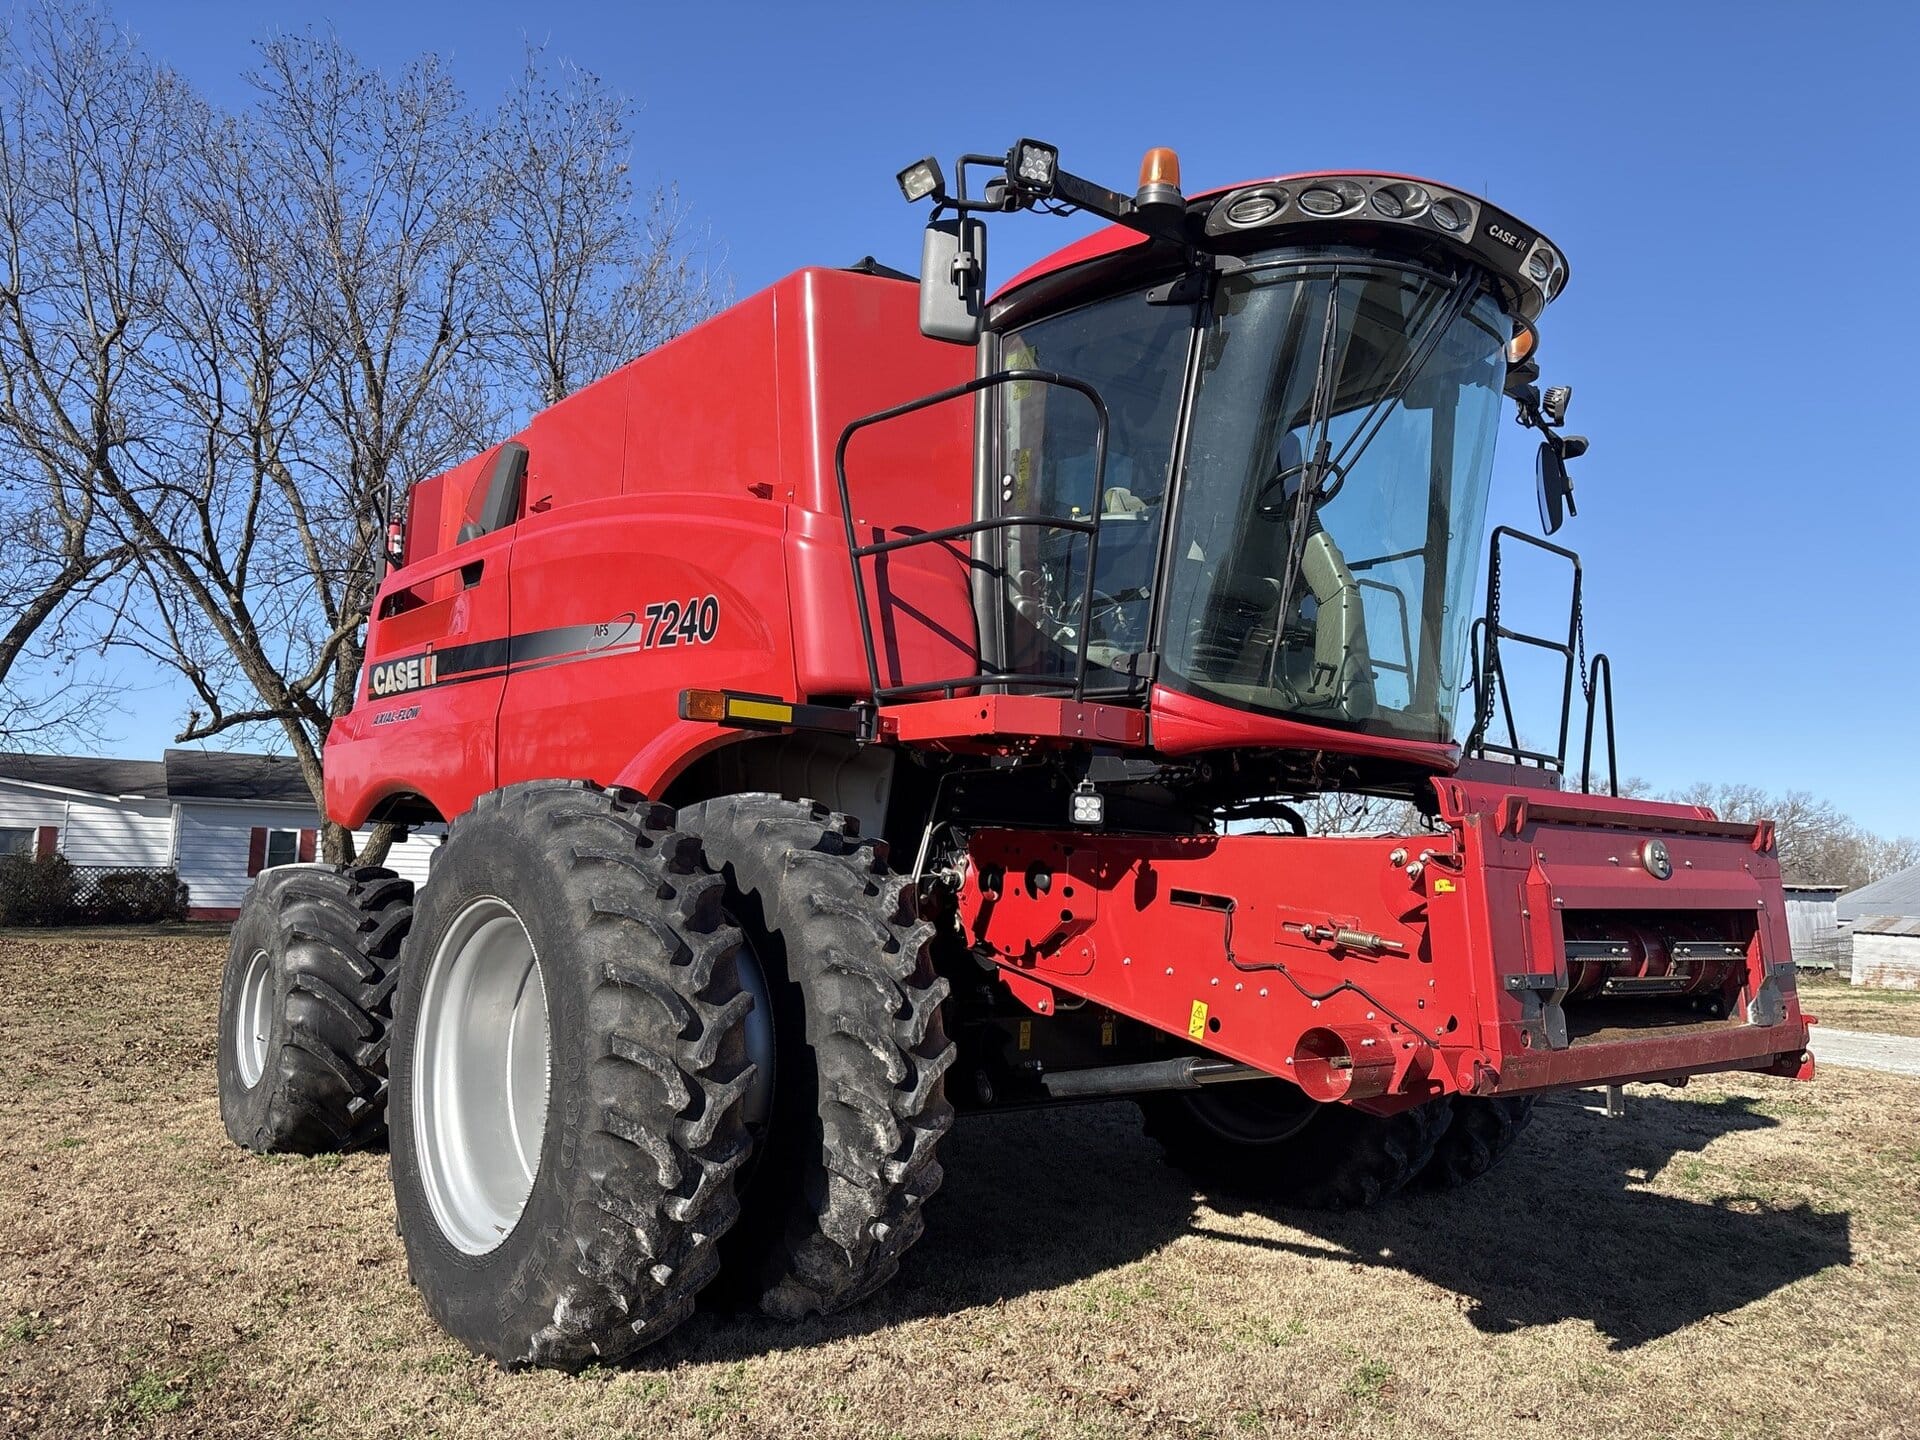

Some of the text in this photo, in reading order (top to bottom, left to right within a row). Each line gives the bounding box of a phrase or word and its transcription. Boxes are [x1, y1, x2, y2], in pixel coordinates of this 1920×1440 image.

[1489, 224, 1517, 246] CASE
[593, 624, 609, 637] AFS
[644, 594, 720, 650] 7240
[373, 659, 419, 695] CASE
[372, 705, 421, 726] AXIAL-FLOW
